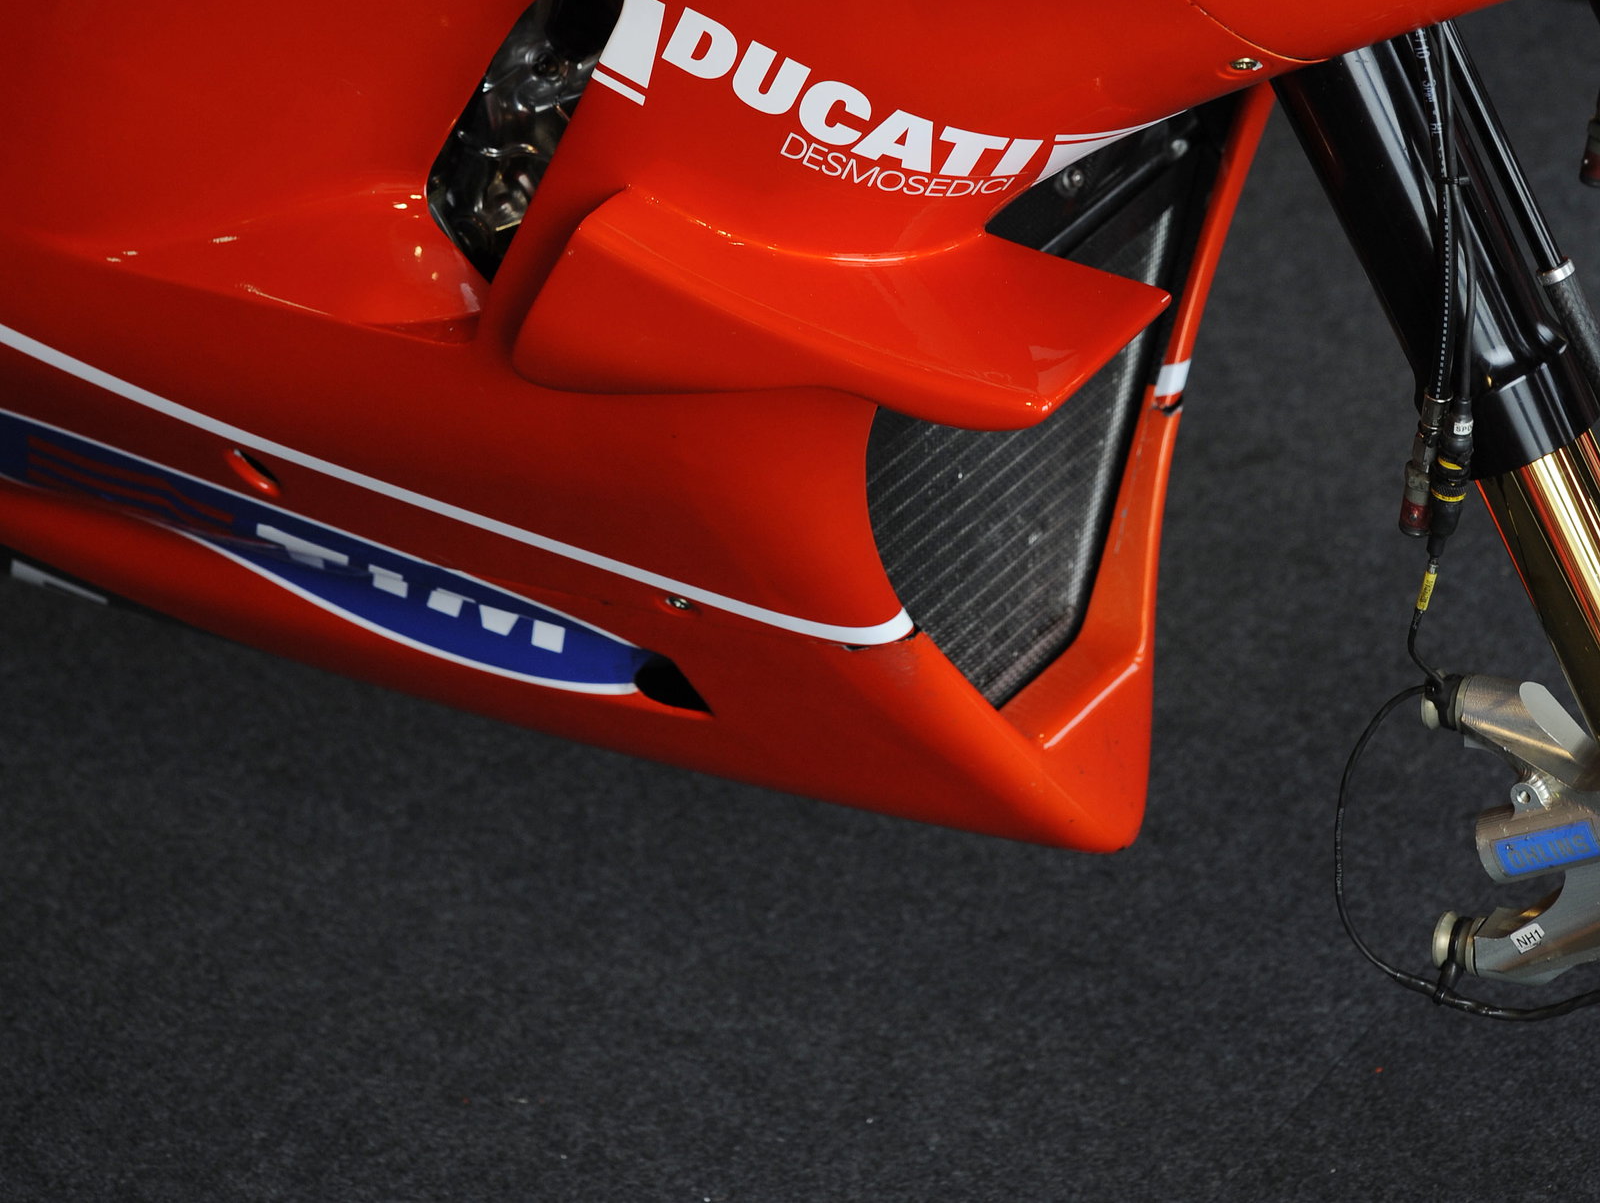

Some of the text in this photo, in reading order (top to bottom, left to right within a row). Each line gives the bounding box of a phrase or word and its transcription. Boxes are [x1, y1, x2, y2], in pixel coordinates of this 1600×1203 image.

[662, 7, 1043, 177] DUCATI
[780, 133, 1015, 197] DESMOSEDICI
[1516, 929, 1543, 948] NH1
